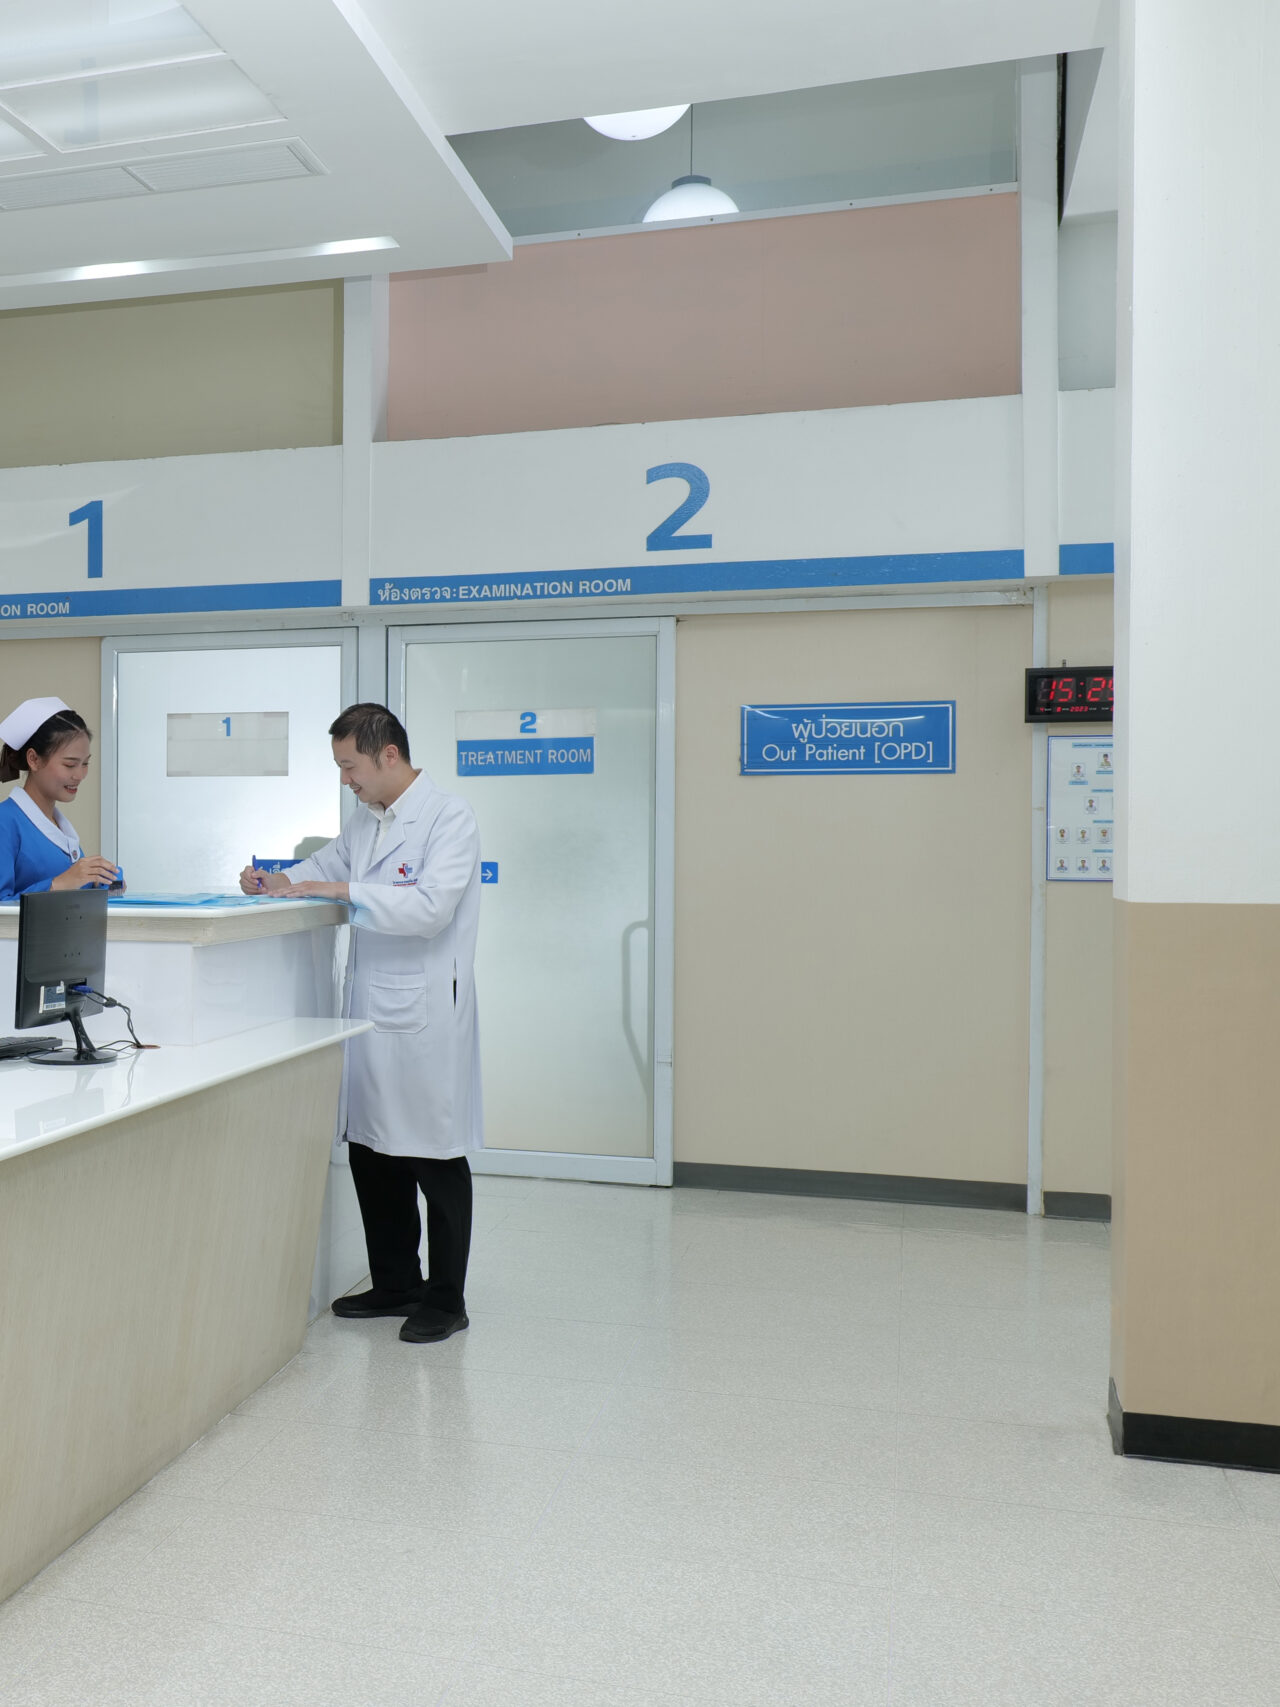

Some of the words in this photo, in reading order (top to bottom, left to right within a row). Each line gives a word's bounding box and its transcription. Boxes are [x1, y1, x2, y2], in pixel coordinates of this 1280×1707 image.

[646, 462, 712, 551] 2
[69, 500, 103, 578] 1
[578, 578, 631, 594] ROOM
[27, 602, 70, 616] ROOM
[222, 717, 231, 736] 1
[520, 712, 536, 733] 2
[792, 714, 904, 743] ผู้ป่วยนอก
[460, 749, 543, 765] TREATMENT
[548, 748, 592, 763] ROOM
[762, 744, 797, 761] Out
[805, 743, 866, 761] Patient
[874, 741, 933, 763] [OPD]
